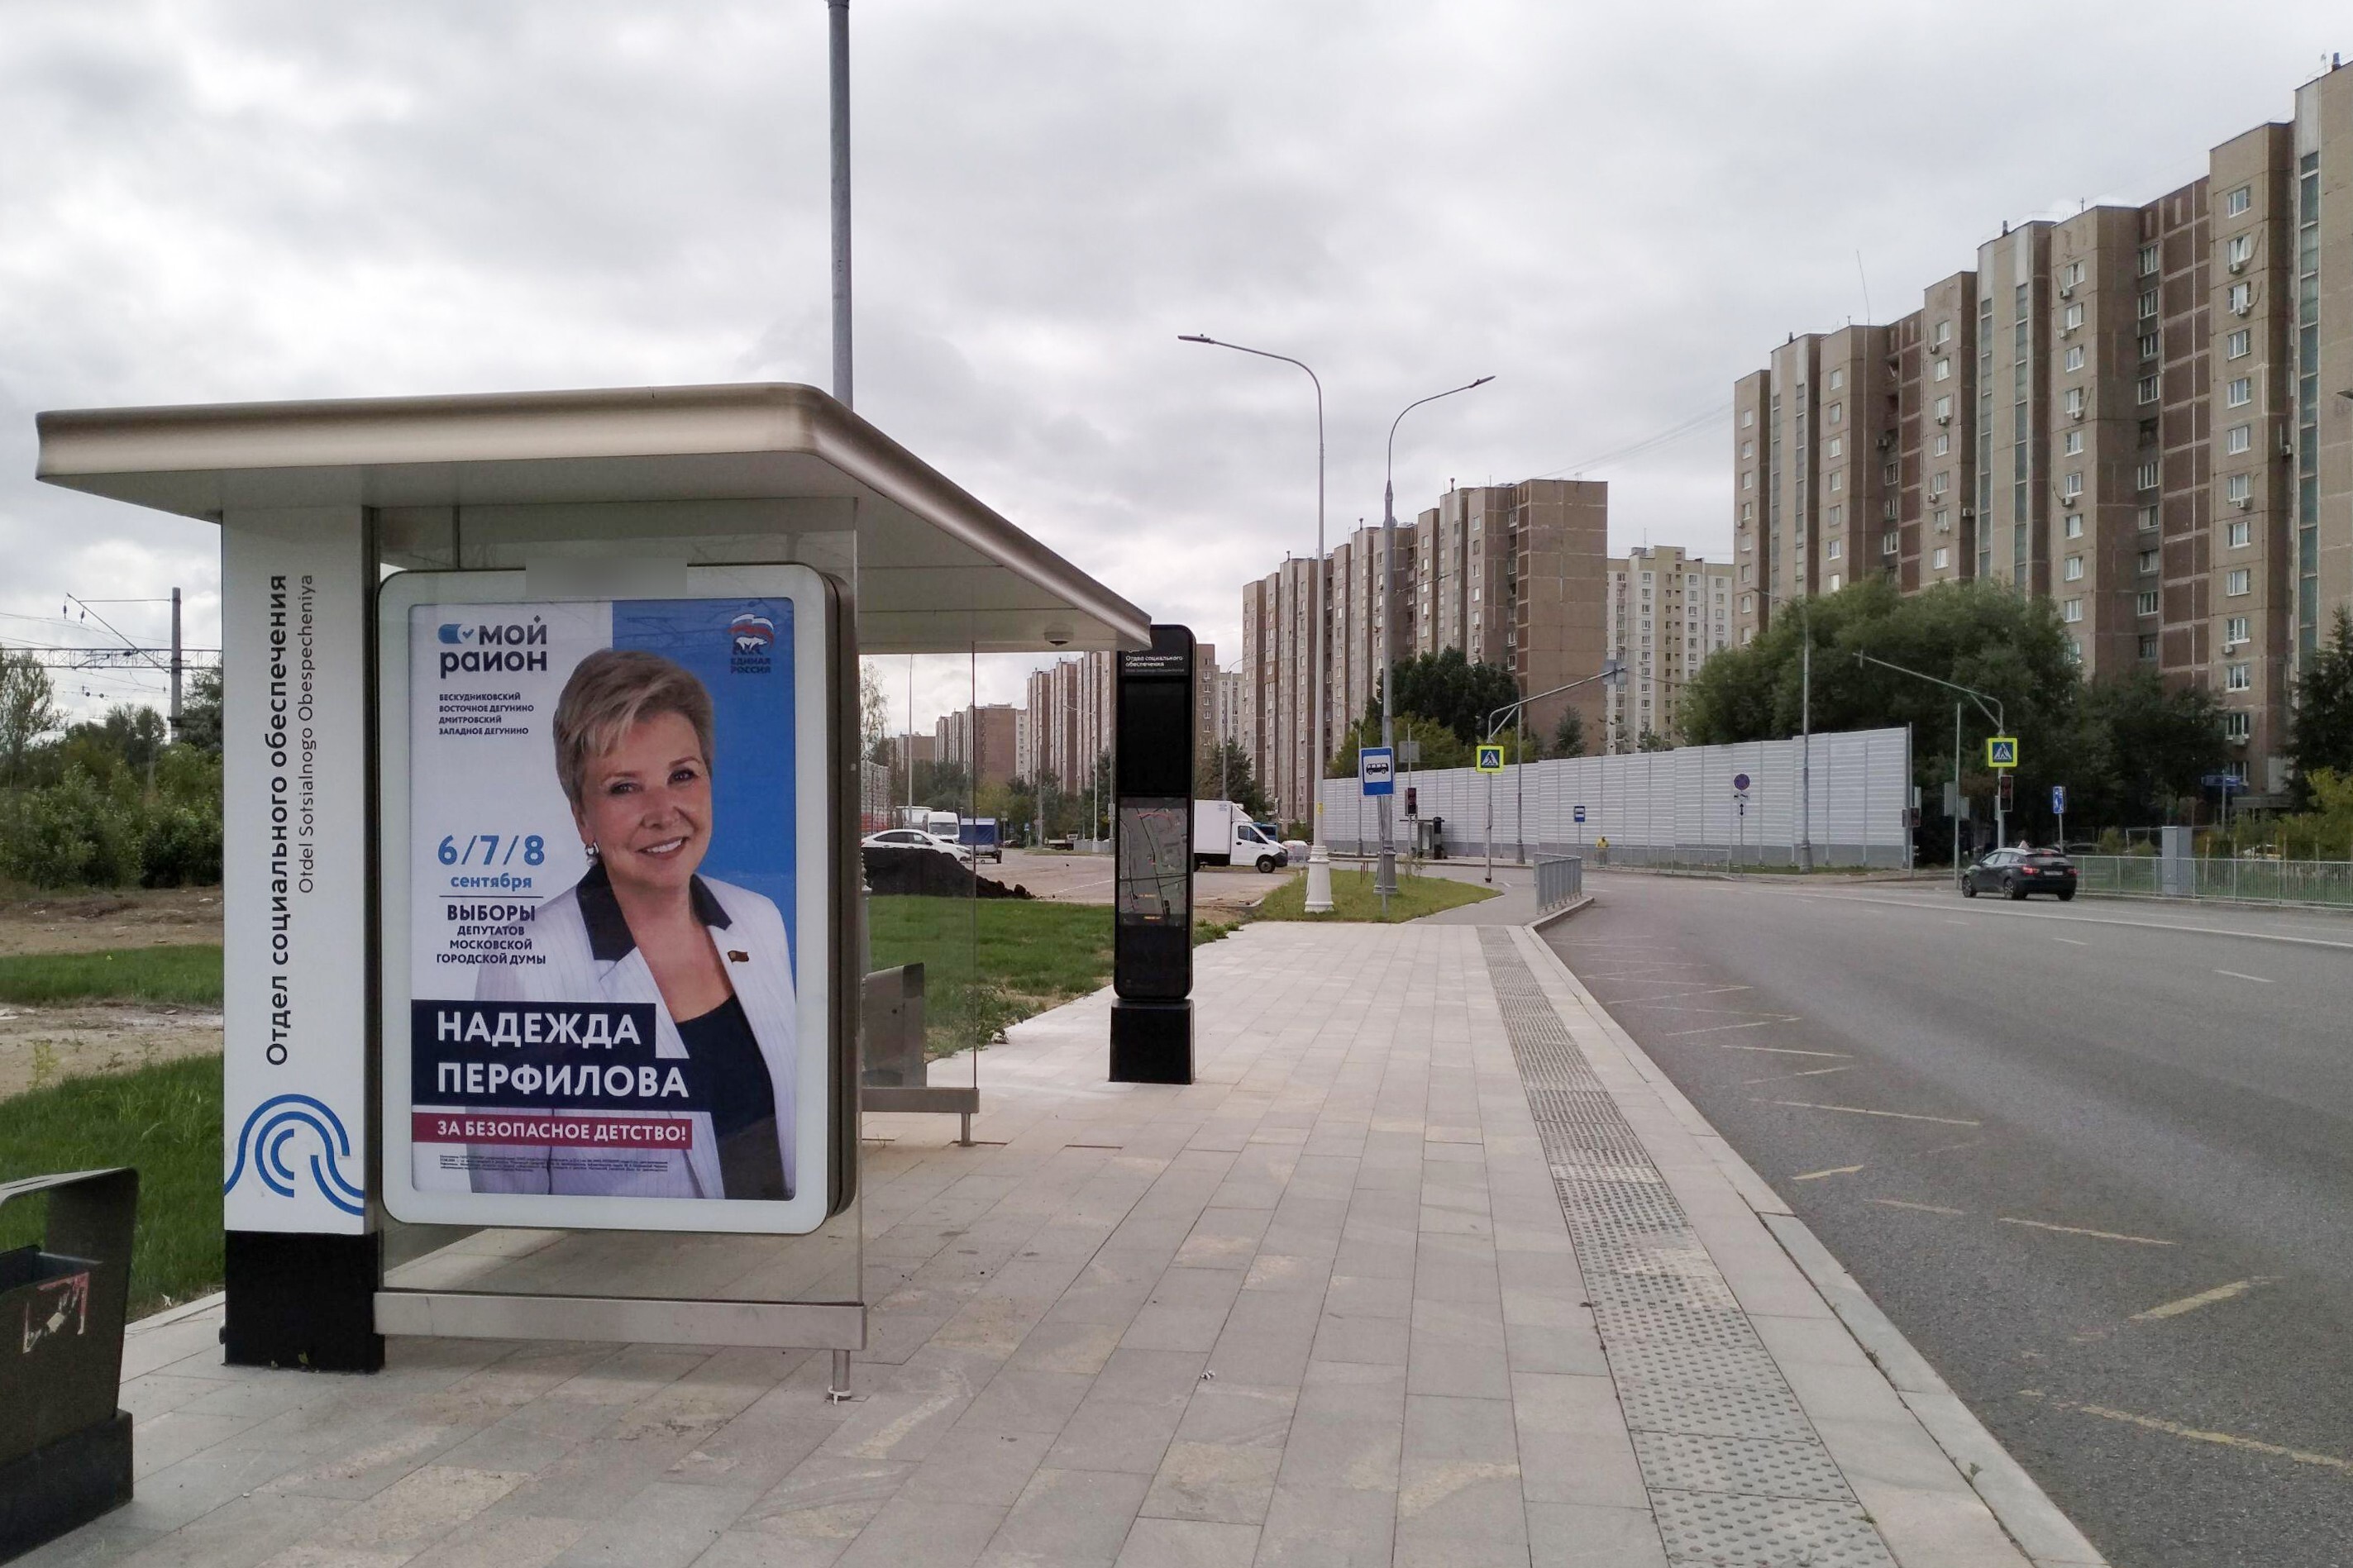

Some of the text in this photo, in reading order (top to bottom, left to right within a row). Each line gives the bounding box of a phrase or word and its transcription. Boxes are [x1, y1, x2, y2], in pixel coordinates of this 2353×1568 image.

[439, 692, 521, 702] БЕСКУДНИКОВСКИЙ
[438, 715, 502, 724] ДМИТРОВСКИЙ
[298, 575, 316, 893] Otdel Sotsialnogo Obespecheniya
[484, 727, 528, 736] ДЕГУНИНО
[265, 575, 291, 1065] Отдел социального обеспечения
[438, 835, 545, 865] 6/7/8
[451, 873, 532, 891] сентября
[447, 904, 536, 921] ВЫБОРЫ
[457, 926, 525, 936] ДЕПУТАТОВ
[450, 938, 532, 950] МОСКОВСКОЙ
[437, 953, 546, 965] ГОРОДСКОЙ ДУМЫ
[437, 1011, 641, 1049] НАДЕЖДА
[437, 1062, 690, 1098] ПЕРФИЛОВА
[437, 1121, 686, 1141] ЗА БЕЗОПАСНОЕ ДЕТСТВО!
